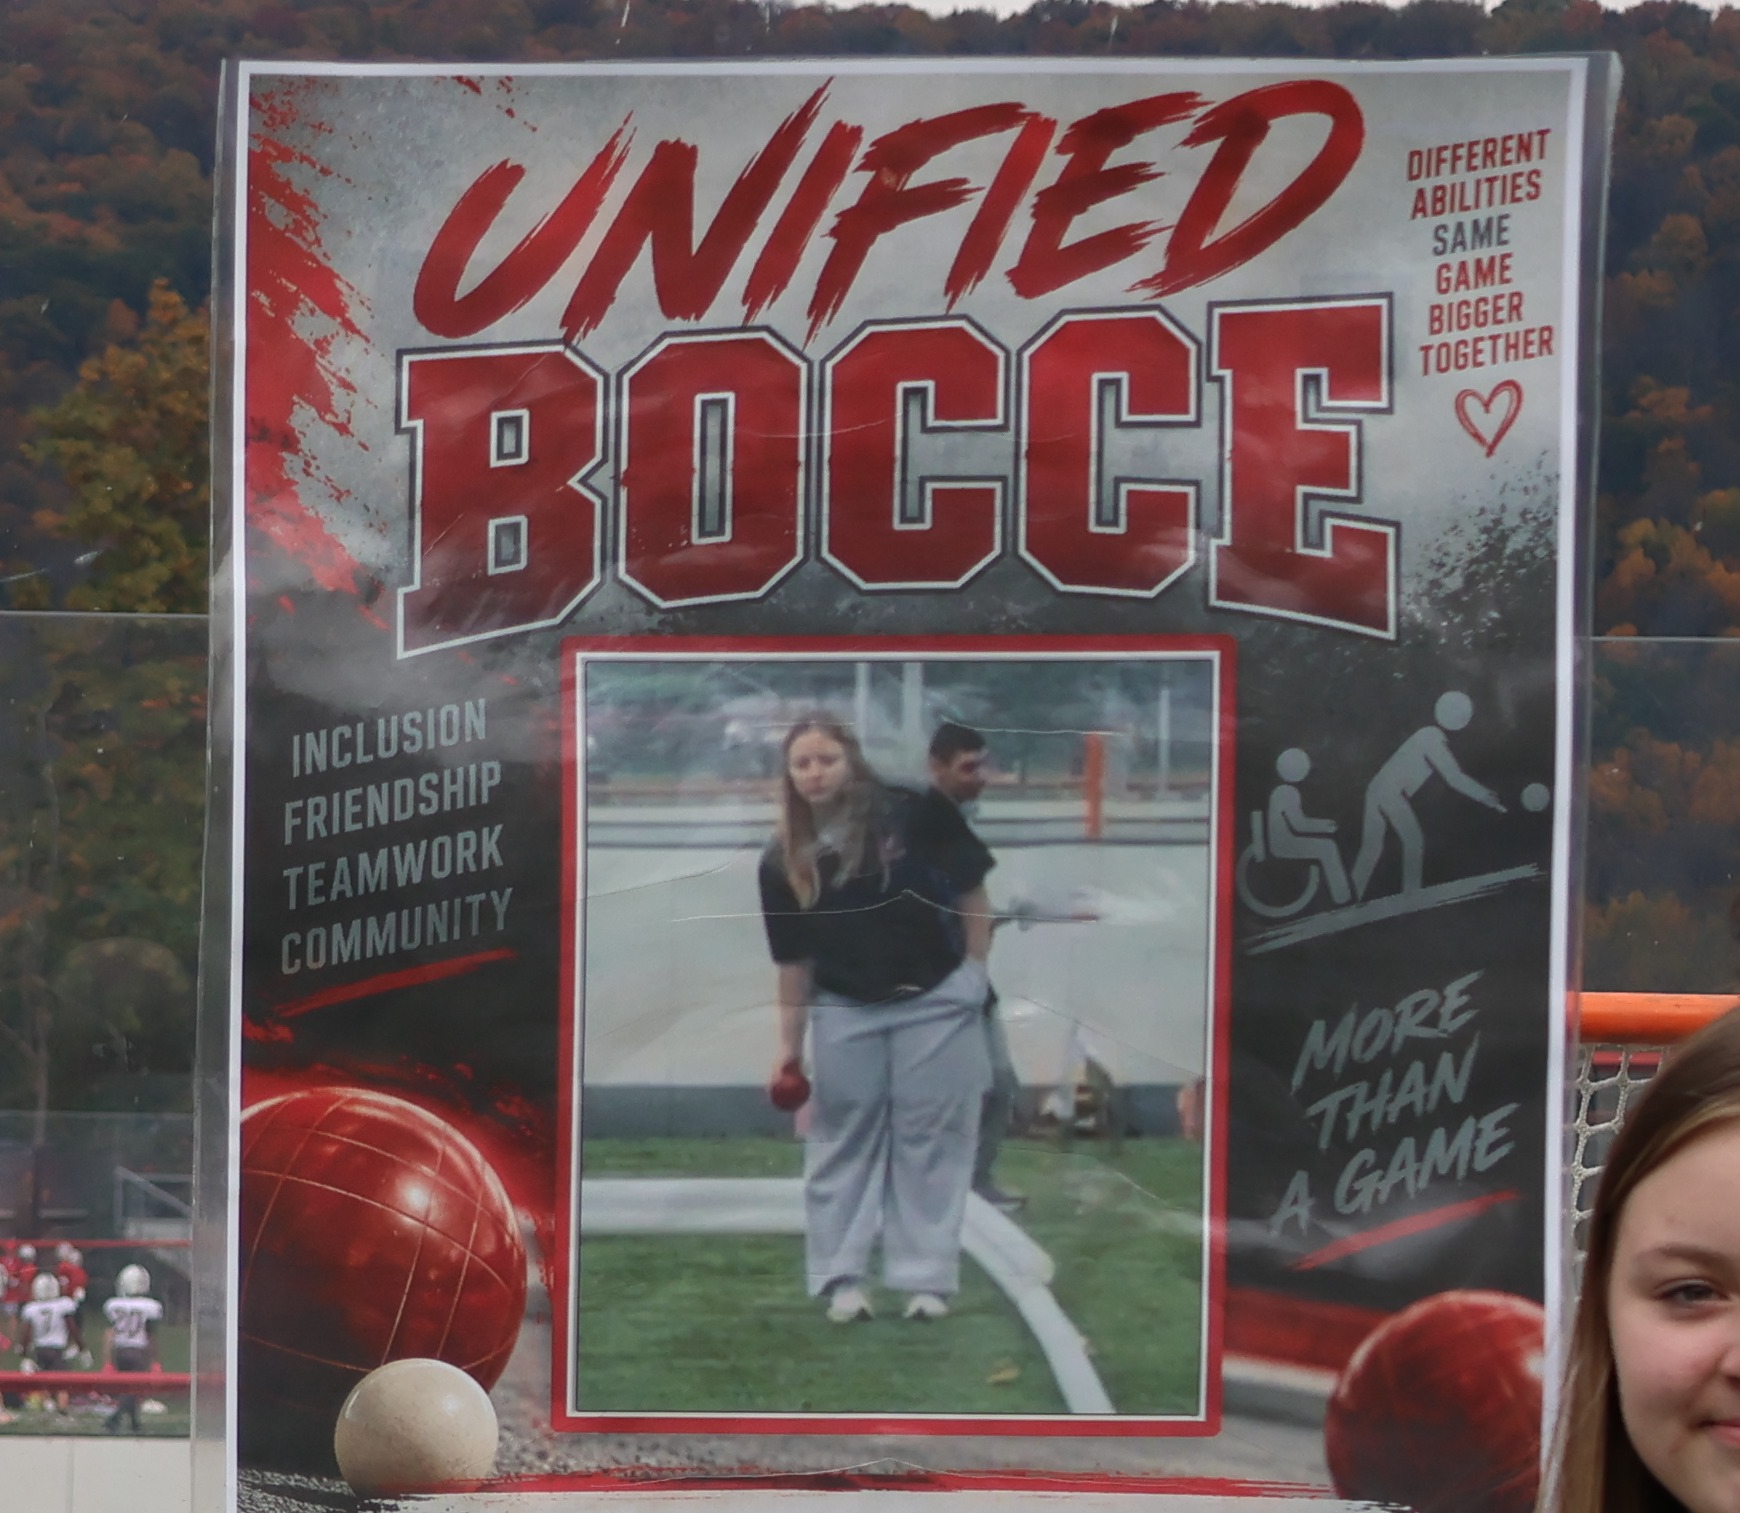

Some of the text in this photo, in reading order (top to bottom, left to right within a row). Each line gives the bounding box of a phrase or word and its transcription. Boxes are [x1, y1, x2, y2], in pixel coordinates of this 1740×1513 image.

[1406, 128, 1552, 182] DIFFERENT
[1410, 169, 1542, 220] ABILITIES
[411, 75, 1367, 347] UNIFIED
[1432, 214, 1511, 256] SAME
[1428, 291, 1524, 336] BIGGER
[1436, 252, 1514, 295] GAME
[1418, 325, 1554, 377] TOGETHER
[395, 292, 1401, 661] BOCCE
[292, 698, 487, 778] INCLUSION
[284, 760, 502, 846] FRIENDSHIP
[283, 823, 504, 910] TEAMWORK
[281, 887, 513, 975] COMMUNITY
[1290, 968, 1486, 1096] MORE
[1304, 1030, 1482, 1154] THAN
[1271, 1102, 1521, 1238] A GAME
